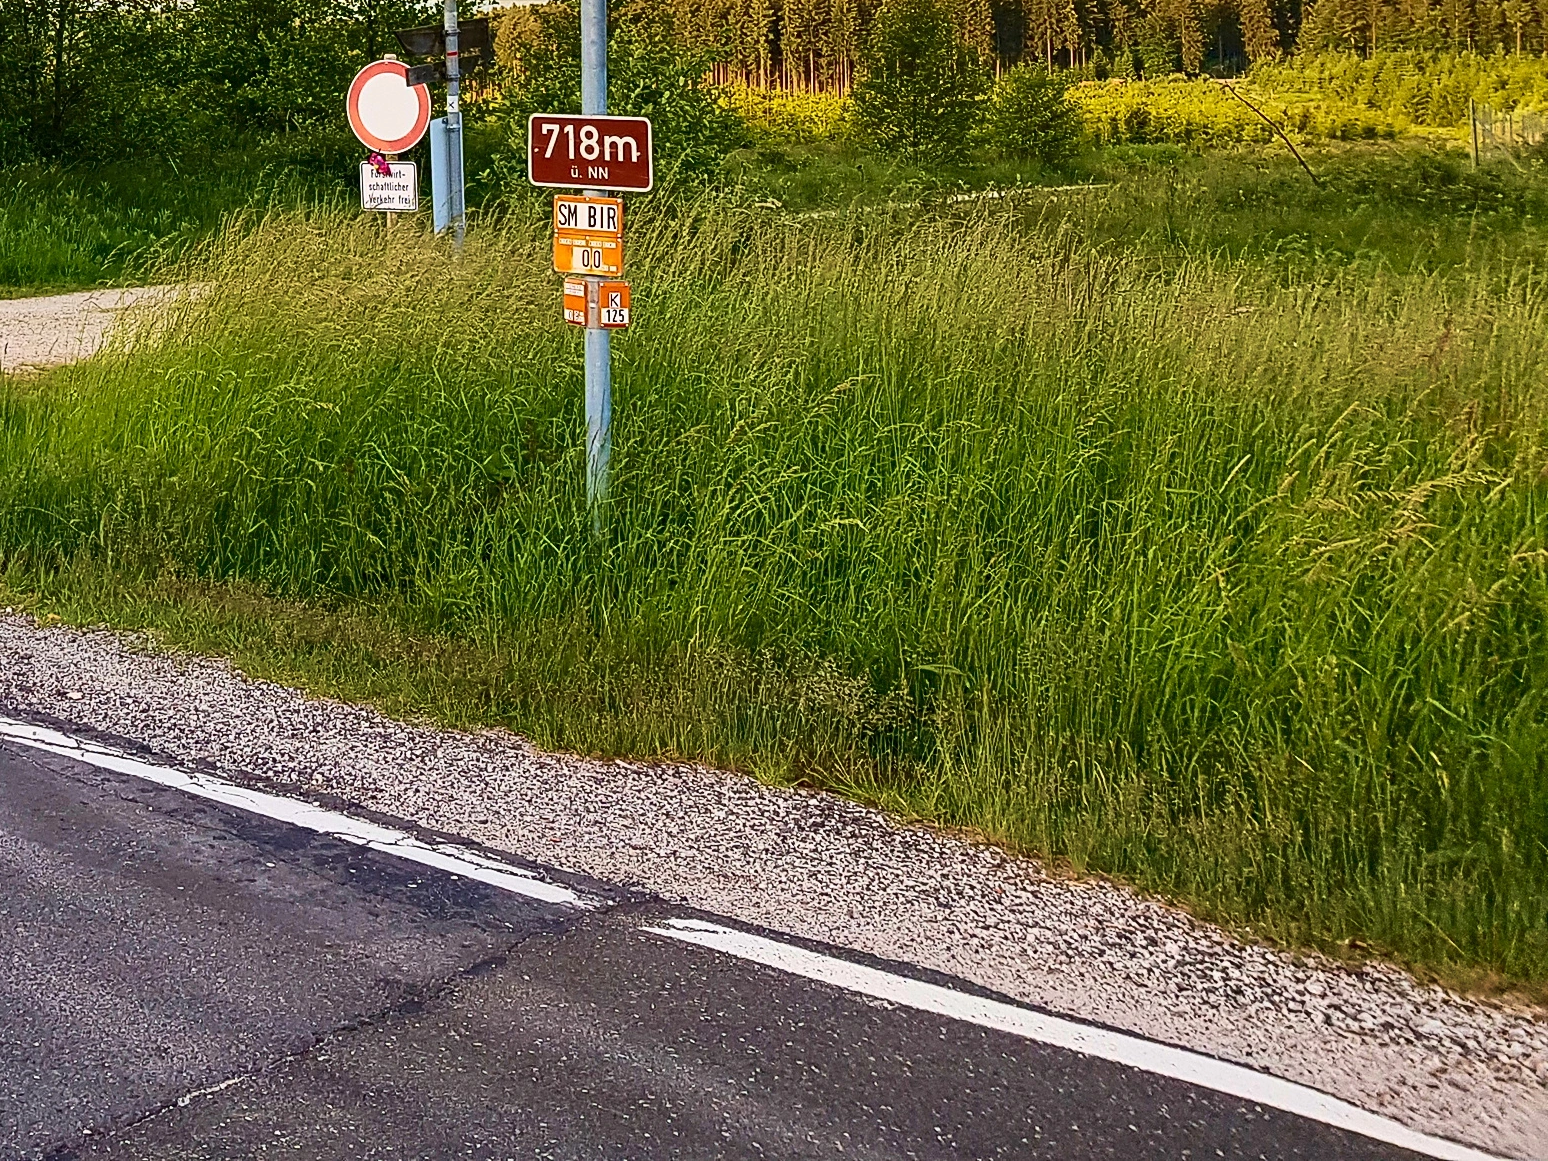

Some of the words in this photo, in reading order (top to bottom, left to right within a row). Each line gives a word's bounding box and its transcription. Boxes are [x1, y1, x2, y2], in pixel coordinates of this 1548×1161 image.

[541, 123, 638, 163] 718m
[570, 166, 583, 178] ü.
[588, 166, 609, 180] NN
[368, 181, 409, 191] schaftlicher
[368, 194, 395, 204] Verkehr
[398, 195, 411, 205] frei
[558, 204, 578, 227] SM
[588, 206, 617, 230] BIR
[610, 293, 619, 307] K
[606, 309, 625, 323] 125
